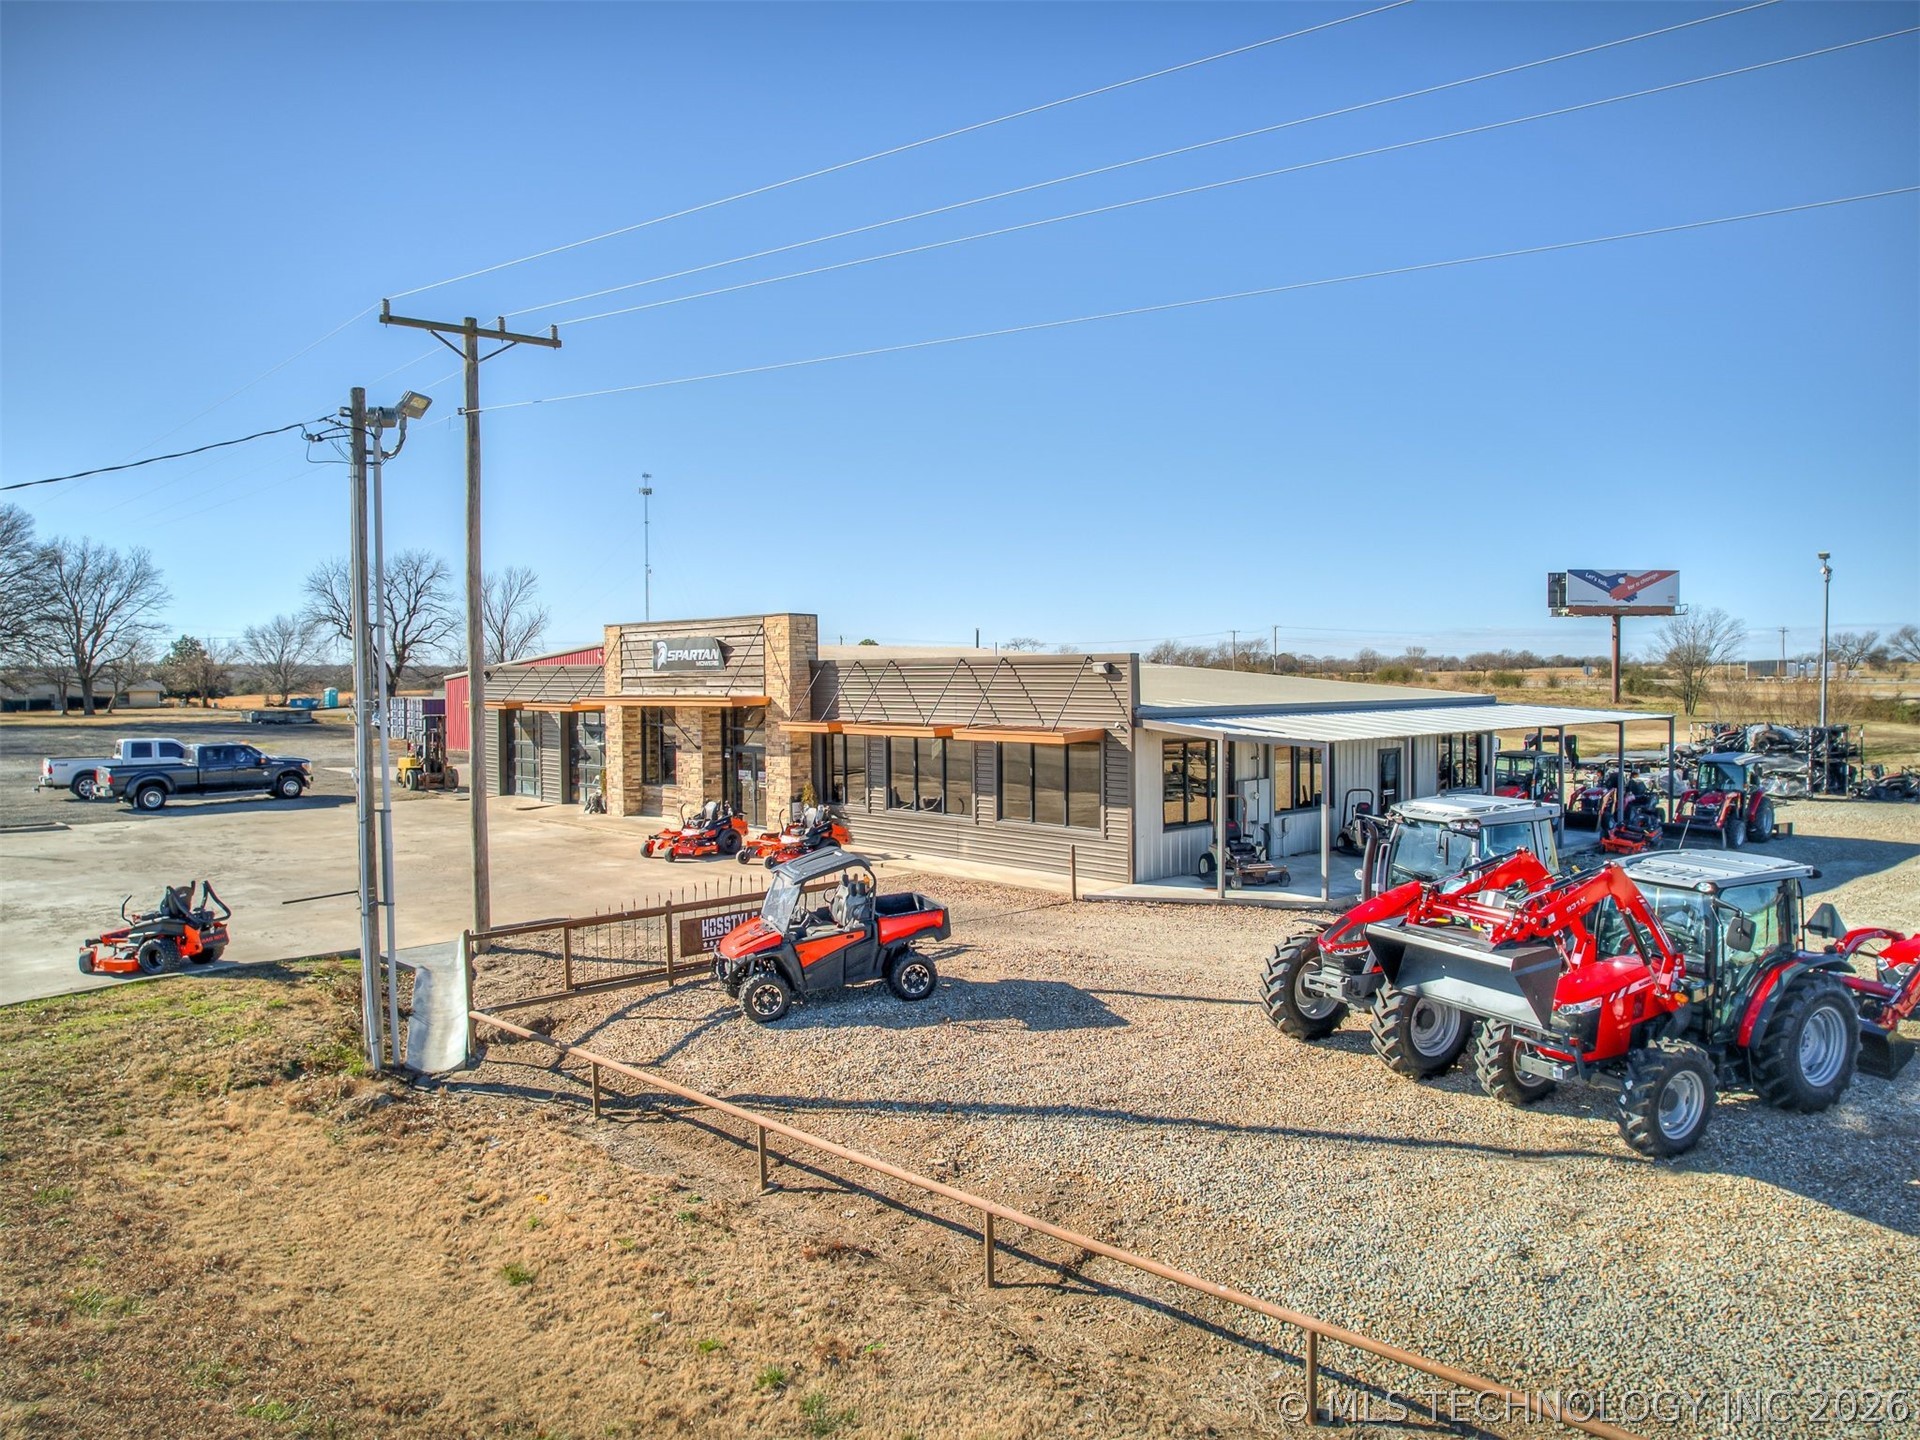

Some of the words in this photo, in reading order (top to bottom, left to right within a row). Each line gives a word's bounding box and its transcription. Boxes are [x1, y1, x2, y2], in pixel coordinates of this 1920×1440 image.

[1585, 572, 1598, 582] Let's
[667, 649, 720, 661] SPARTAN
[1566, 897, 1586, 913] 931X
